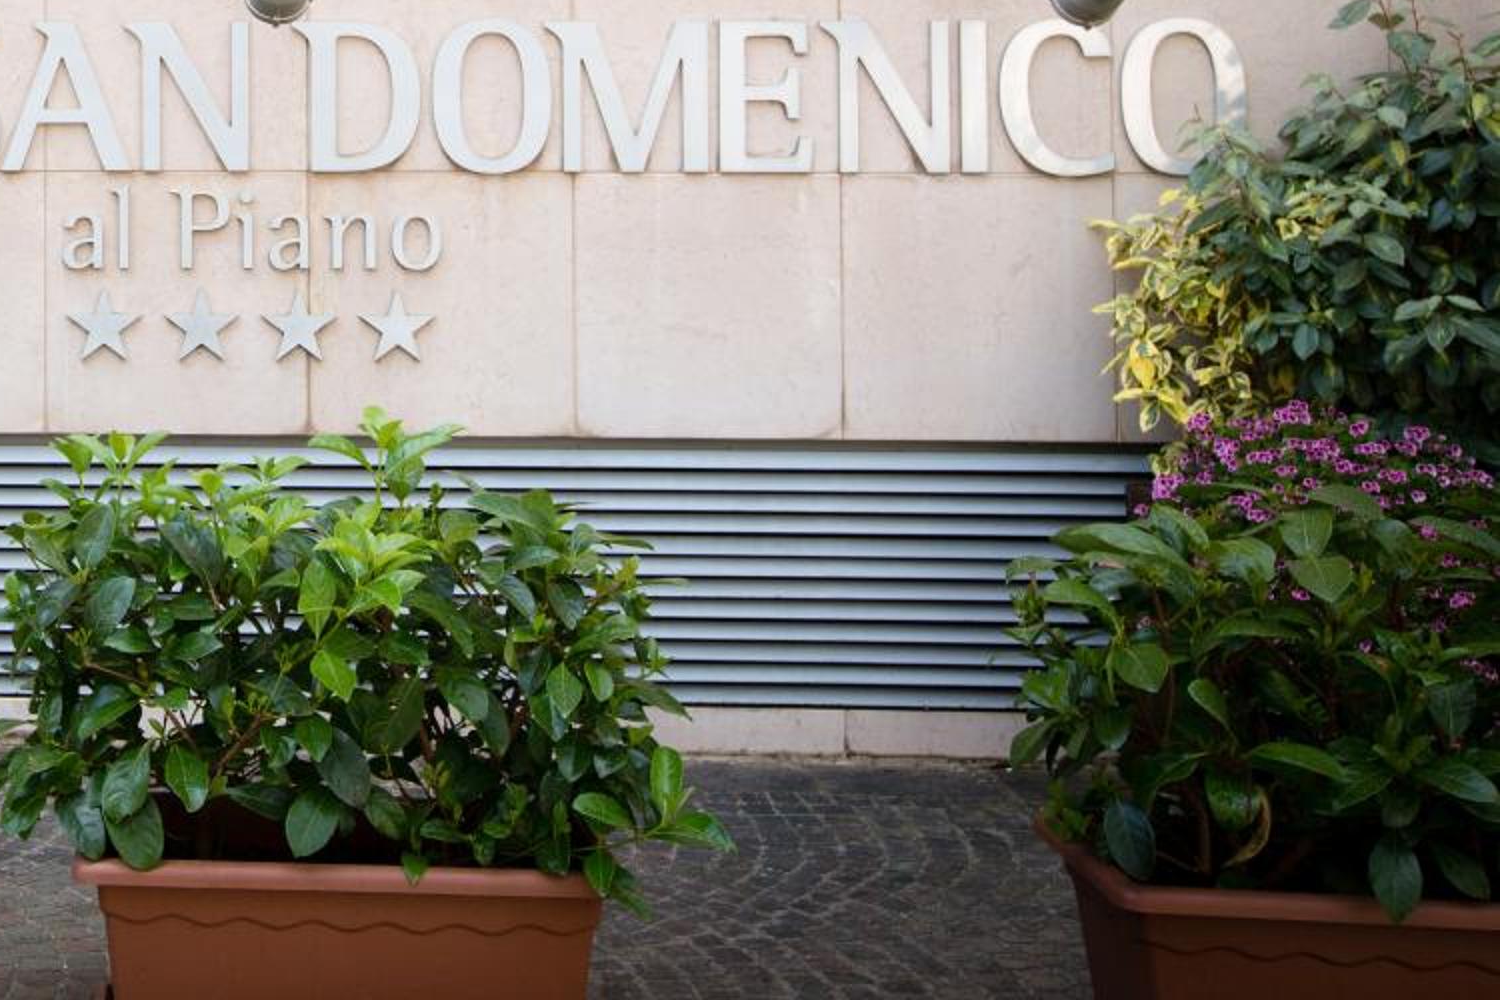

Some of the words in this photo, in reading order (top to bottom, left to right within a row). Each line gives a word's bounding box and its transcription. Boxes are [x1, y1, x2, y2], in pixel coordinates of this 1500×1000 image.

[291, 18, 1248, 177] DOMENICO
[61, 183, 132, 272] al
[167, 183, 444, 273] Piano
